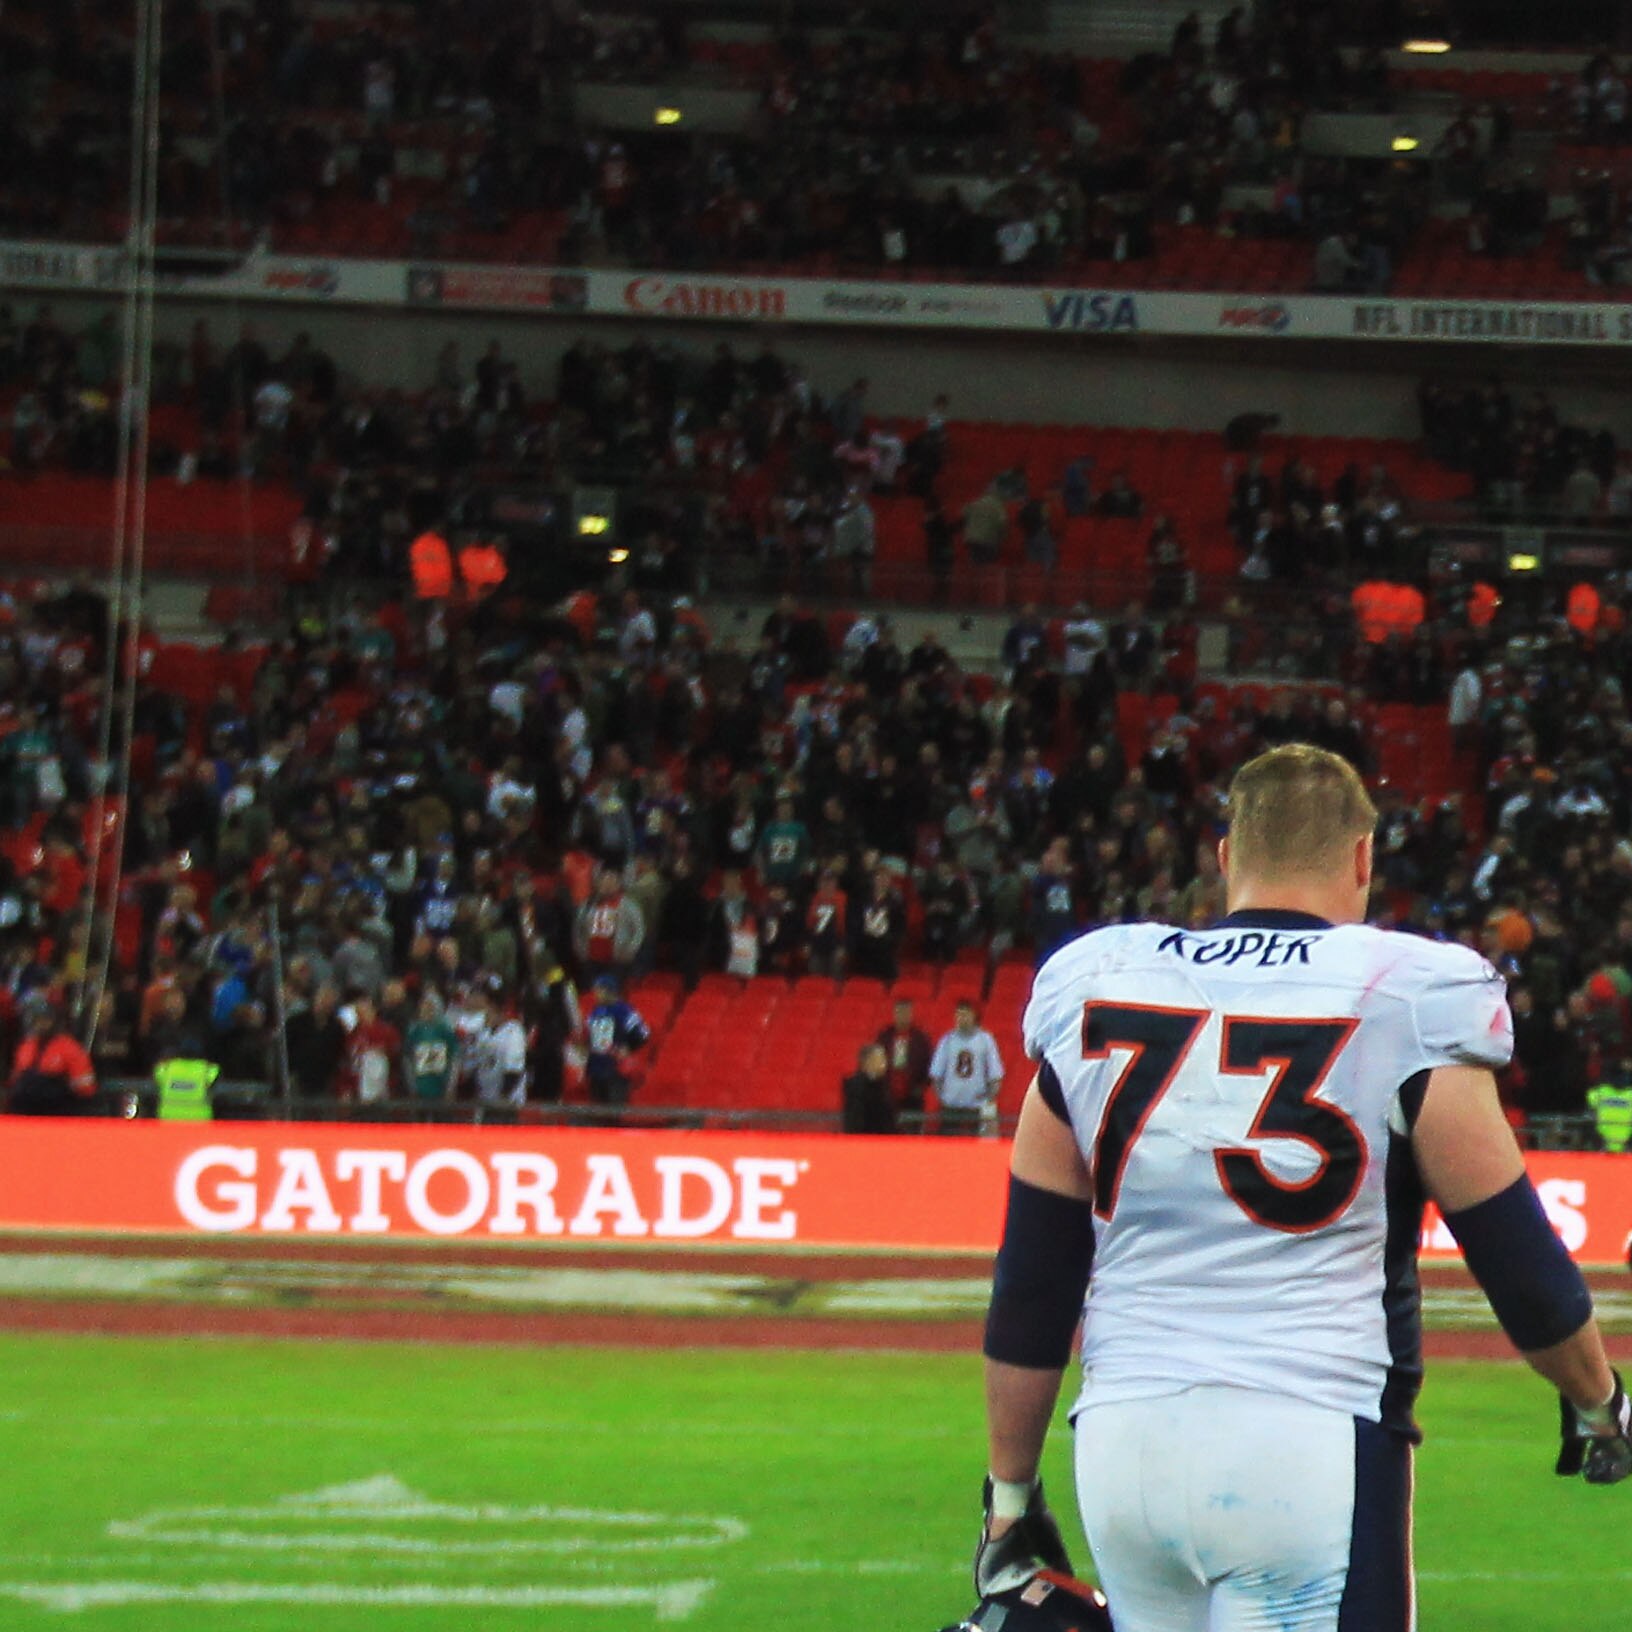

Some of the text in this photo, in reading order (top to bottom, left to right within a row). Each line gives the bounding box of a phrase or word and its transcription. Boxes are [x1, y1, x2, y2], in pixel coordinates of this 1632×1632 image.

[624, 277, 785, 317] Canon
[1043, 293, 1138, 330] VISA
[1353, 305, 1400, 333] NFL
[1411, 308, 1608, 338] INTERNATIONAL
[1082, 999, 1368, 1235] 73
[174, 1145, 800, 1240] GATORADE
